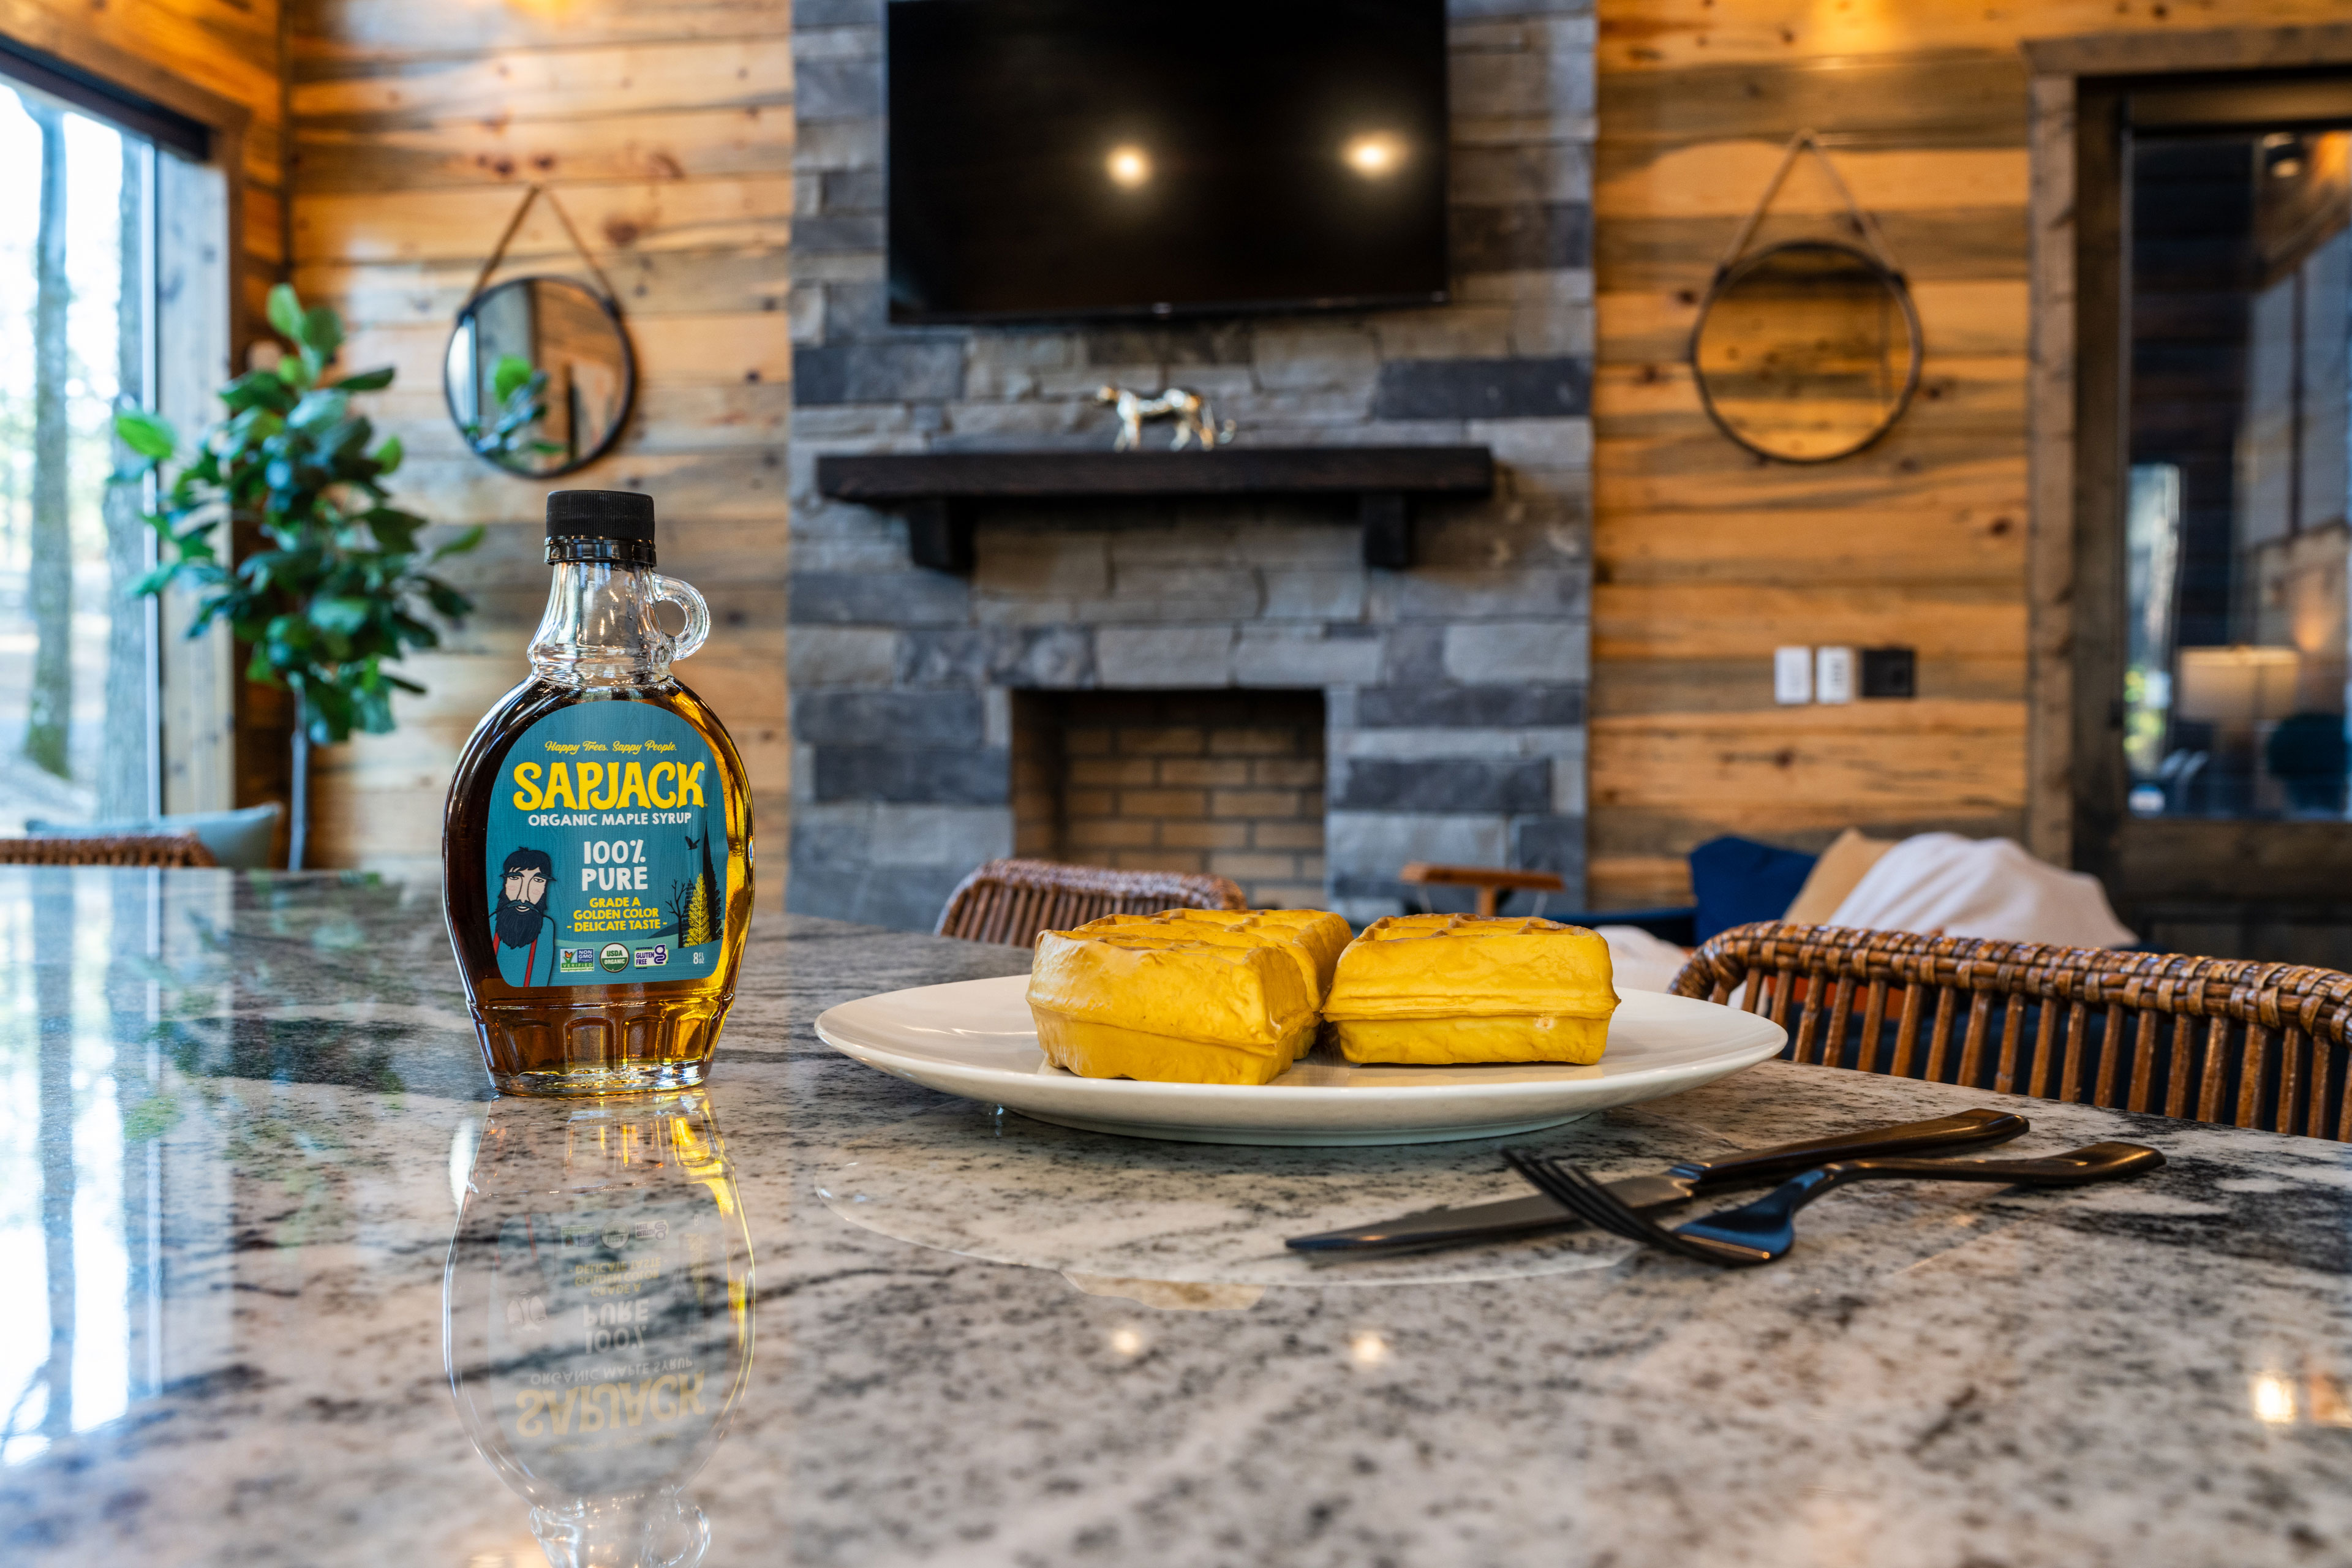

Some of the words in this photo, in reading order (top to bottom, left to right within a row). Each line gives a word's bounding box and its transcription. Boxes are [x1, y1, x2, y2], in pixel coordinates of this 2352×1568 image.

[545, 741, 580, 755] Happy
[582, 741, 608, 751] Trees.
[612, 741, 642, 755] Sappy
[644, 740, 677, 753] People.
[513, 761, 705, 810] SAPJACK
[528, 813, 597, 826] ORGANIC
[601, 813, 648, 826] MAPLE
[652, 812, 692, 824] SYRUP
[584, 839, 646, 864] 100%
[582, 866, 649, 891] PURE
[589, 897, 629, 908] GRADE
[631, 897, 641, 907] A
[573, 909, 620, 920] GOLDEN
[623, 908, 659, 919] COLOR
[574, 921, 626, 932] DELICATE
[628, 919, 661, 930] TASTE
[693, 952, 699, 964] 8
